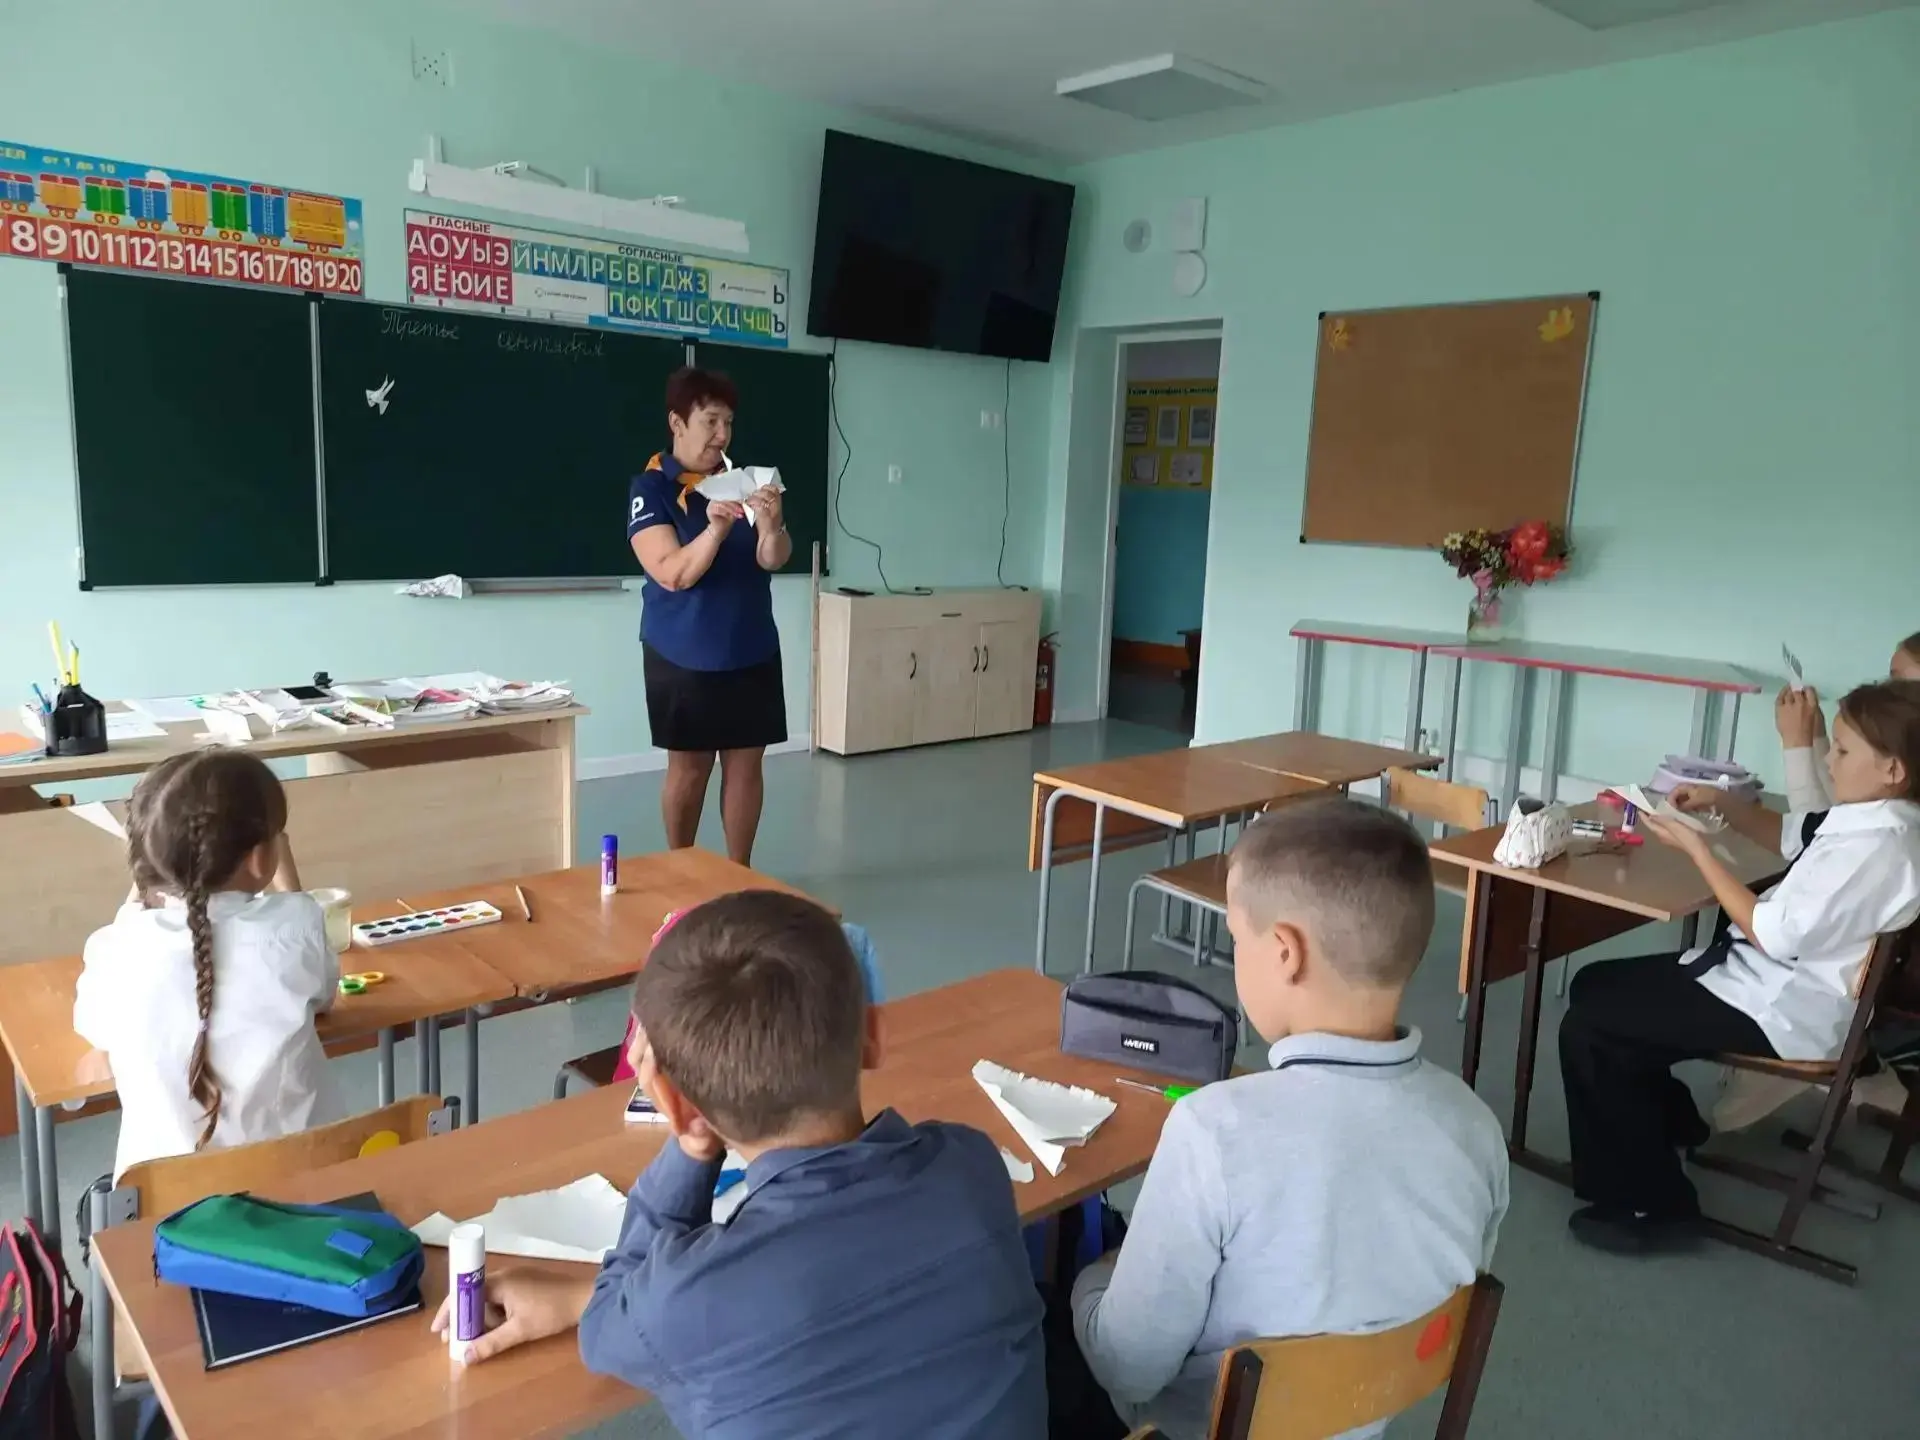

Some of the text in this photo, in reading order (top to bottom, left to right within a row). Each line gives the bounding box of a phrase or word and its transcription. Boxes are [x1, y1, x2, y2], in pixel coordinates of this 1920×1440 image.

[428, 215, 491, 234] ГЛАСНЫЕ
[11, 220, 361, 292] 8 9 10 11 12 13 14 15 16 17 18 19 20
[618, 245, 684, 264] СОГЛАСНЫЕ
[774, 285, 785, 305] Ь
